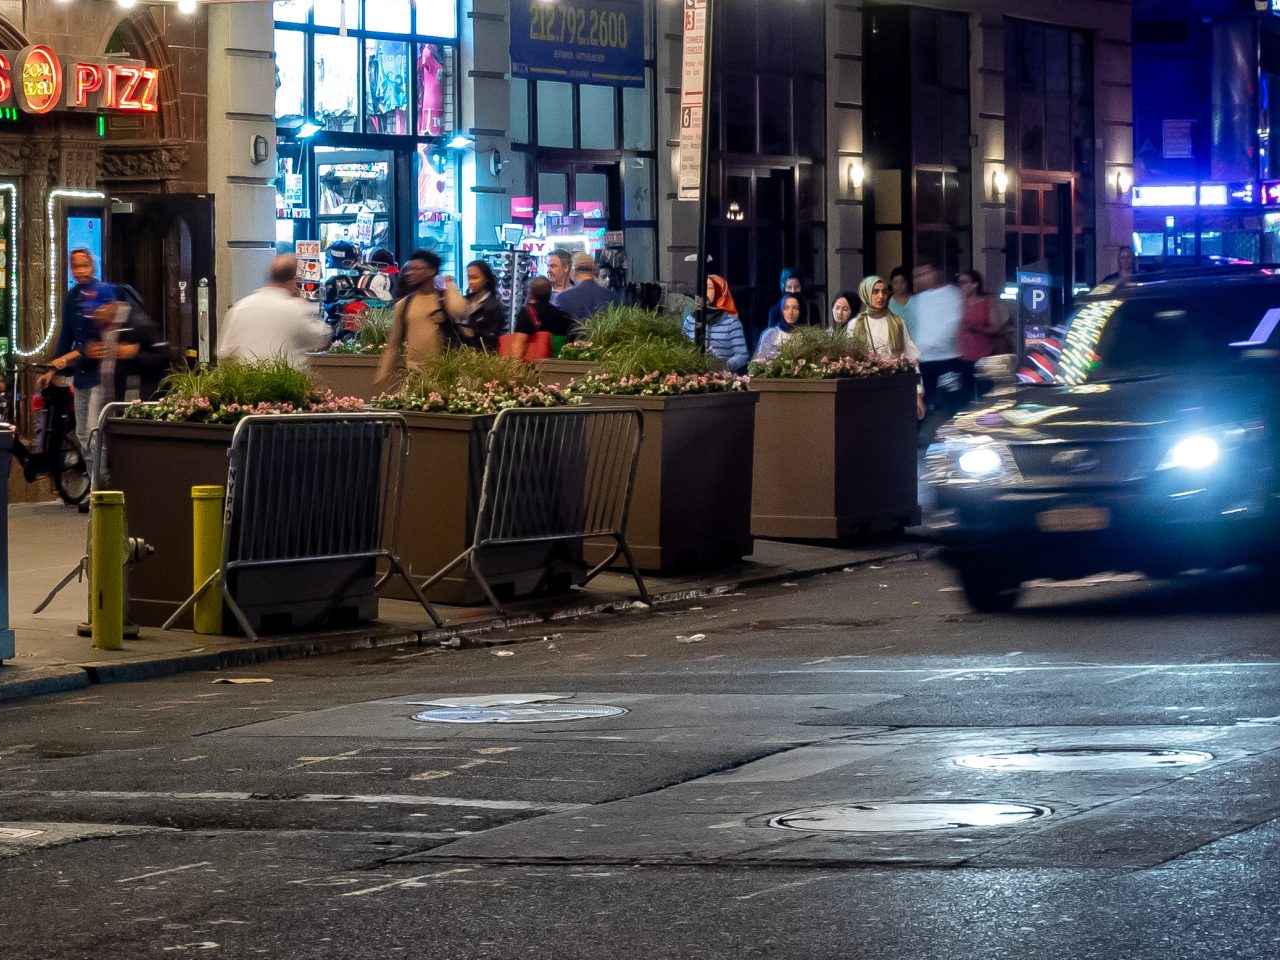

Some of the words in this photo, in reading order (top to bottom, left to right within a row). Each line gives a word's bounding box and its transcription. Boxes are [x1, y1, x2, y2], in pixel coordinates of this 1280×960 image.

[522, 243, 546, 252] NY
[1033, 289, 1045, 309] P
[225, 468, 236, 521] NYPD
